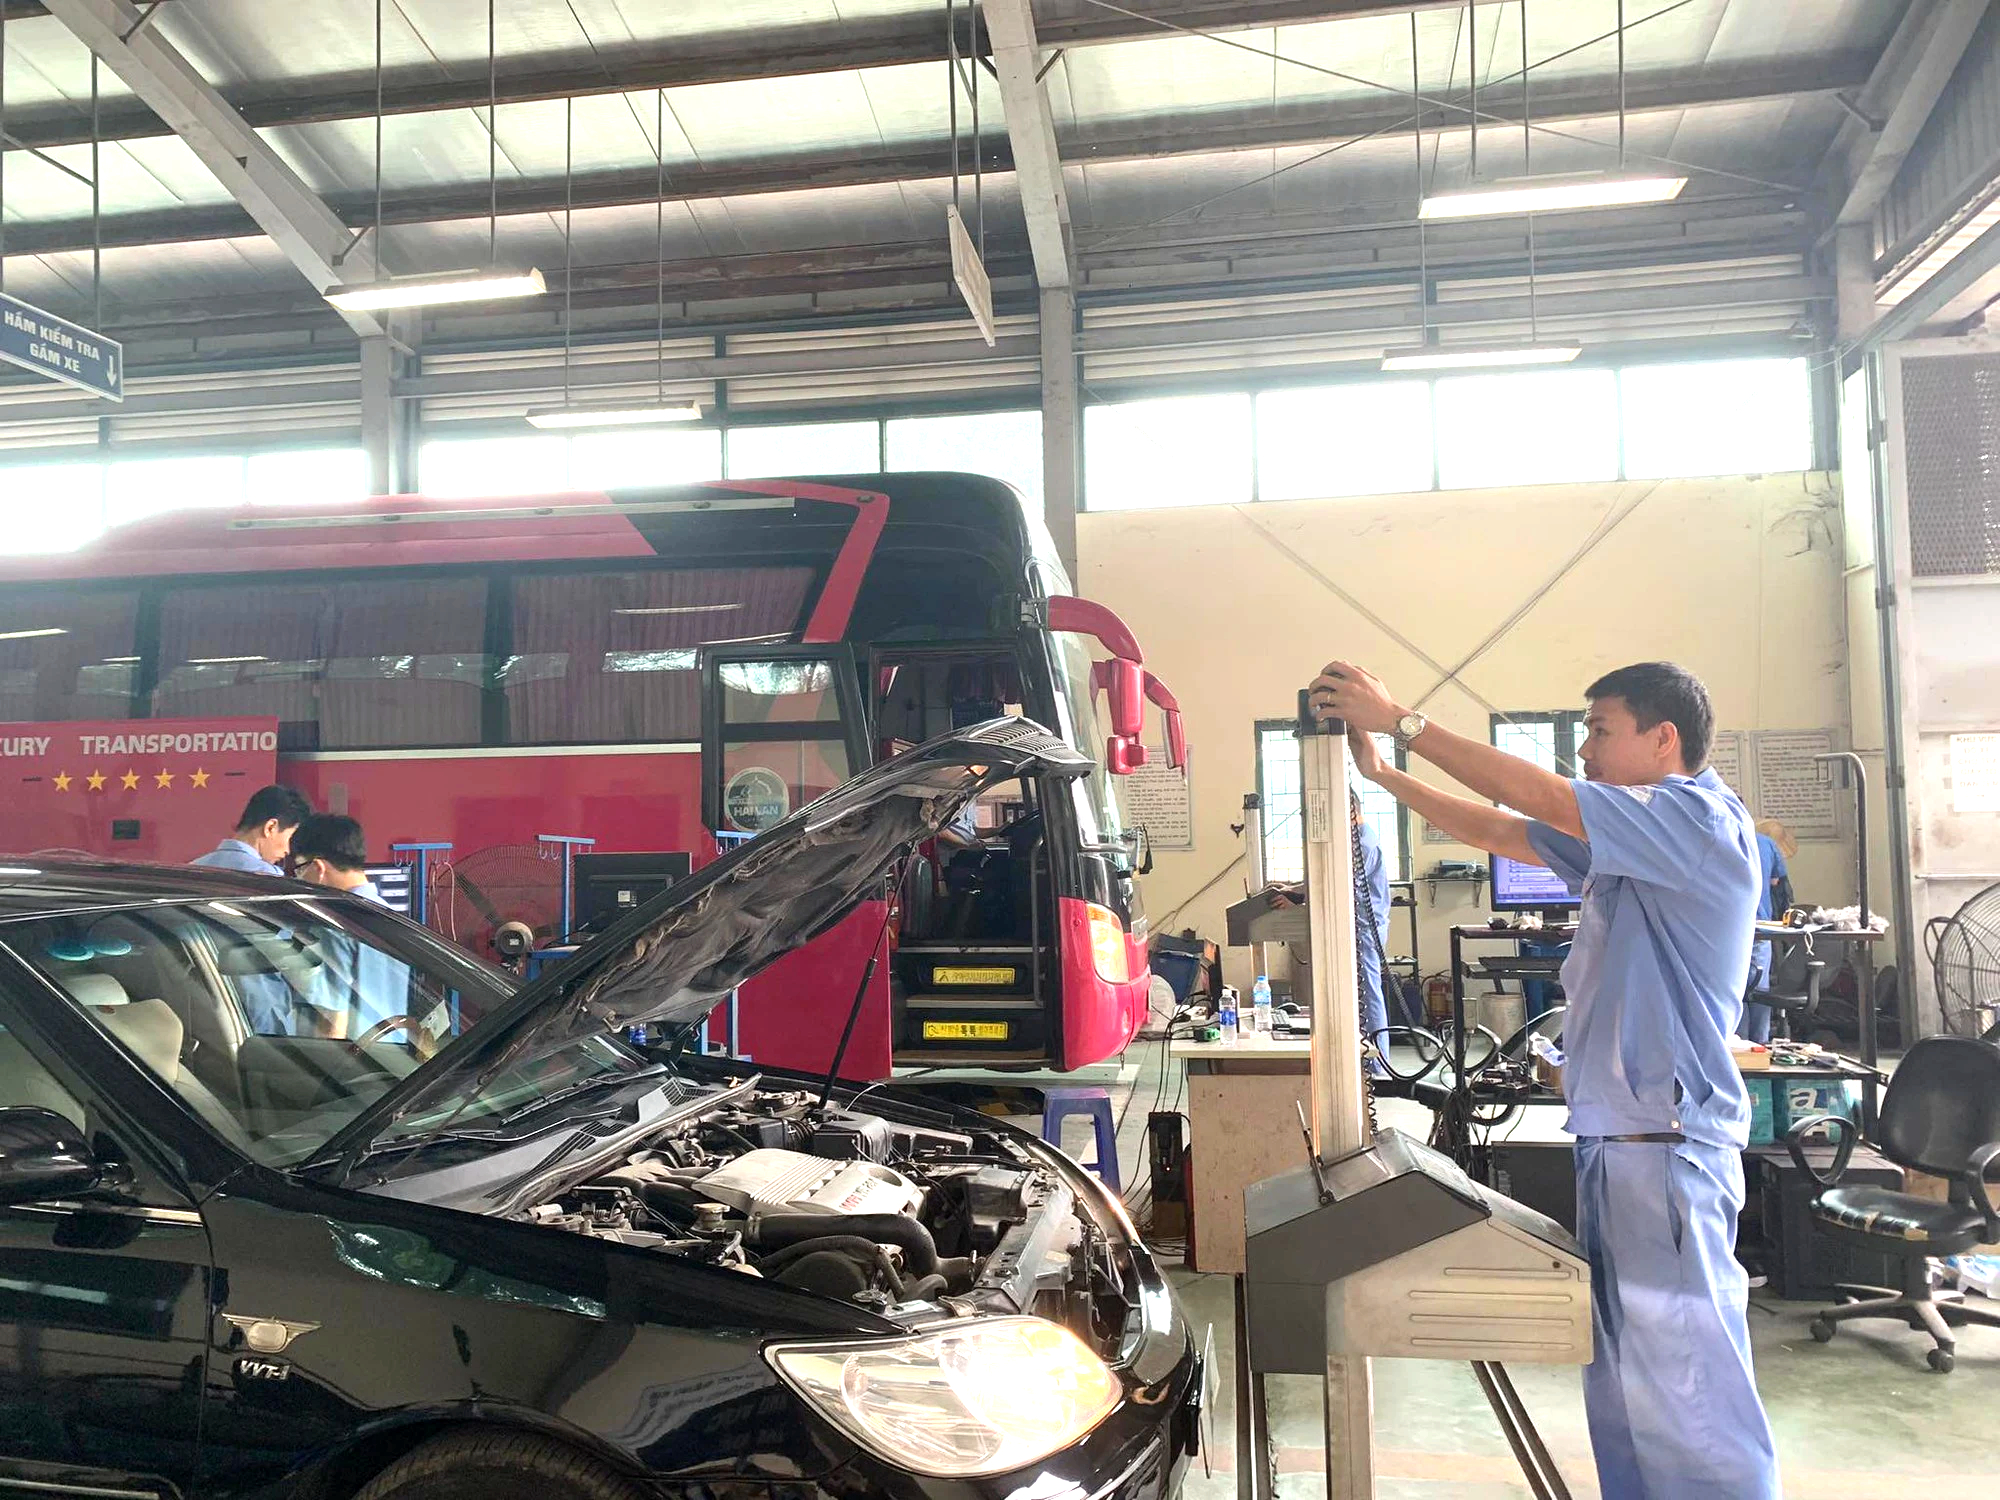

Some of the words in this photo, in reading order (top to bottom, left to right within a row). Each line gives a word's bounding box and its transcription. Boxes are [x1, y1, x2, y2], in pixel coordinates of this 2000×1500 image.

[76, 340, 100, 361] TRA
[64, 356, 81, 373] XE
[0, 737, 51, 756] URY
[79, 731, 277, 755] TRANSPORTATIO
